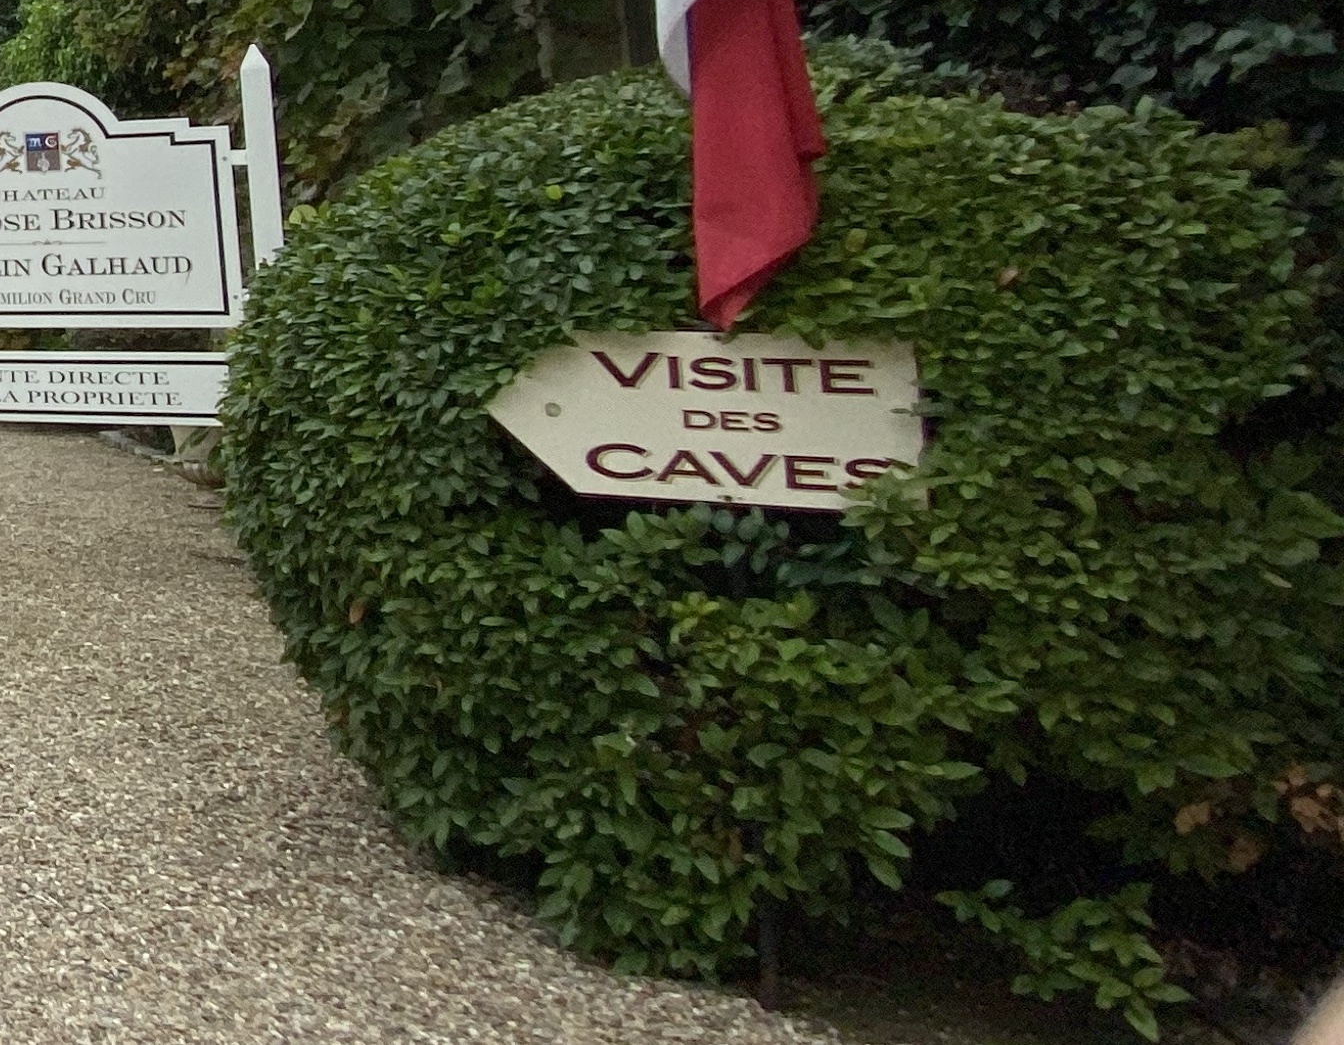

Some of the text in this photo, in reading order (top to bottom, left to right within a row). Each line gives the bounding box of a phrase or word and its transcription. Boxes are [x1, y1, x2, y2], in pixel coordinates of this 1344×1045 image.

[49, 208, 187, 231] BRISSON
[41, 253, 193, 277] GALHAUD
[58, 288, 116, 305] GRAND
[122, 288, 156, 304] CRU
[48, 370, 170, 386] DIRECTE
[590, 350, 877, 396] VISITE
[27, 390, 183, 406] PROPRIETE
[681, 408, 782, 433] DES
[585, 442, 892, 492] CAVES
